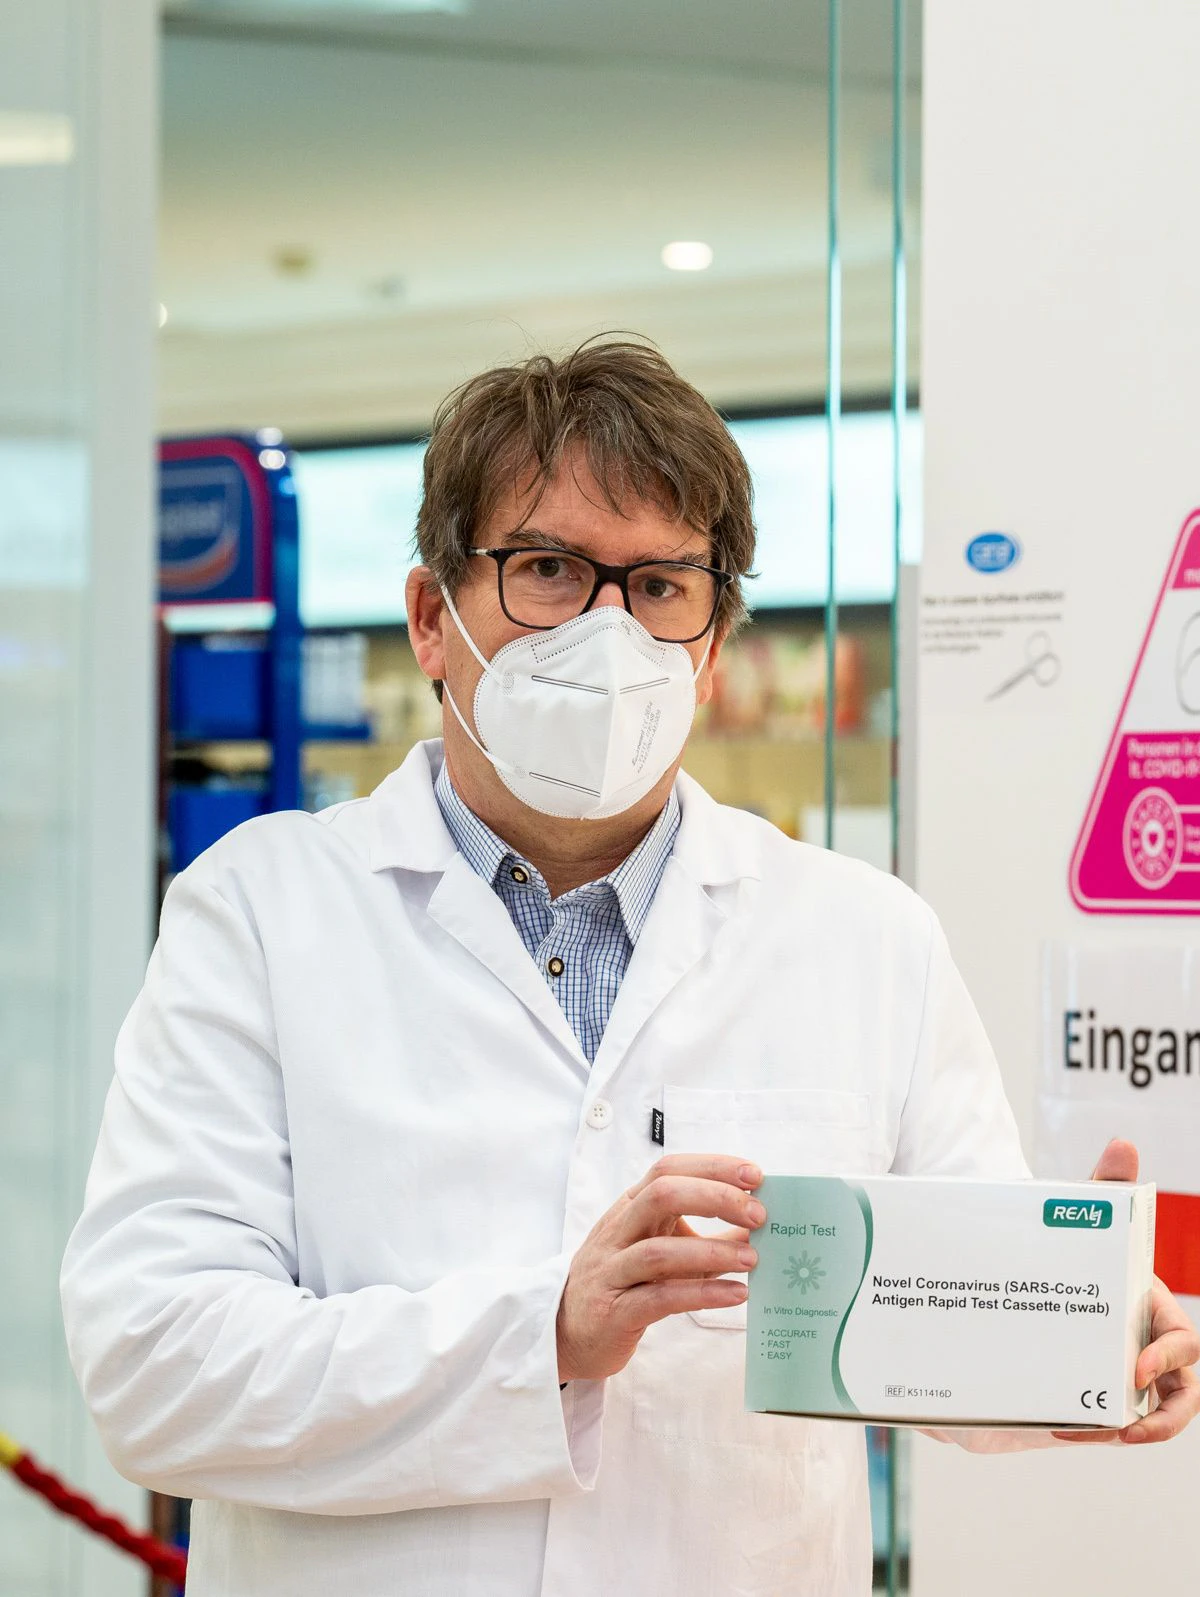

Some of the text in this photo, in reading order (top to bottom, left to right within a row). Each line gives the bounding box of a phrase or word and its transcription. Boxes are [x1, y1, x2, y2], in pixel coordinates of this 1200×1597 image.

[770, 1223, 836, 1237] Rapid Test
[873, 1276, 1100, 1298] Novel Coronavirus (SARS-Cov-2)
[872, 1294, 1109, 1316] Antigen Rapid Test Cassette (swab)
[764, 1306, 838, 1317] In Vitro Diagnostic
[767, 1329, 817, 1338] ACCURATE
[767, 1340, 791, 1348] FAST
[767, 1352, 792, 1360] EASY
[887, 1387, 903, 1396] REF
